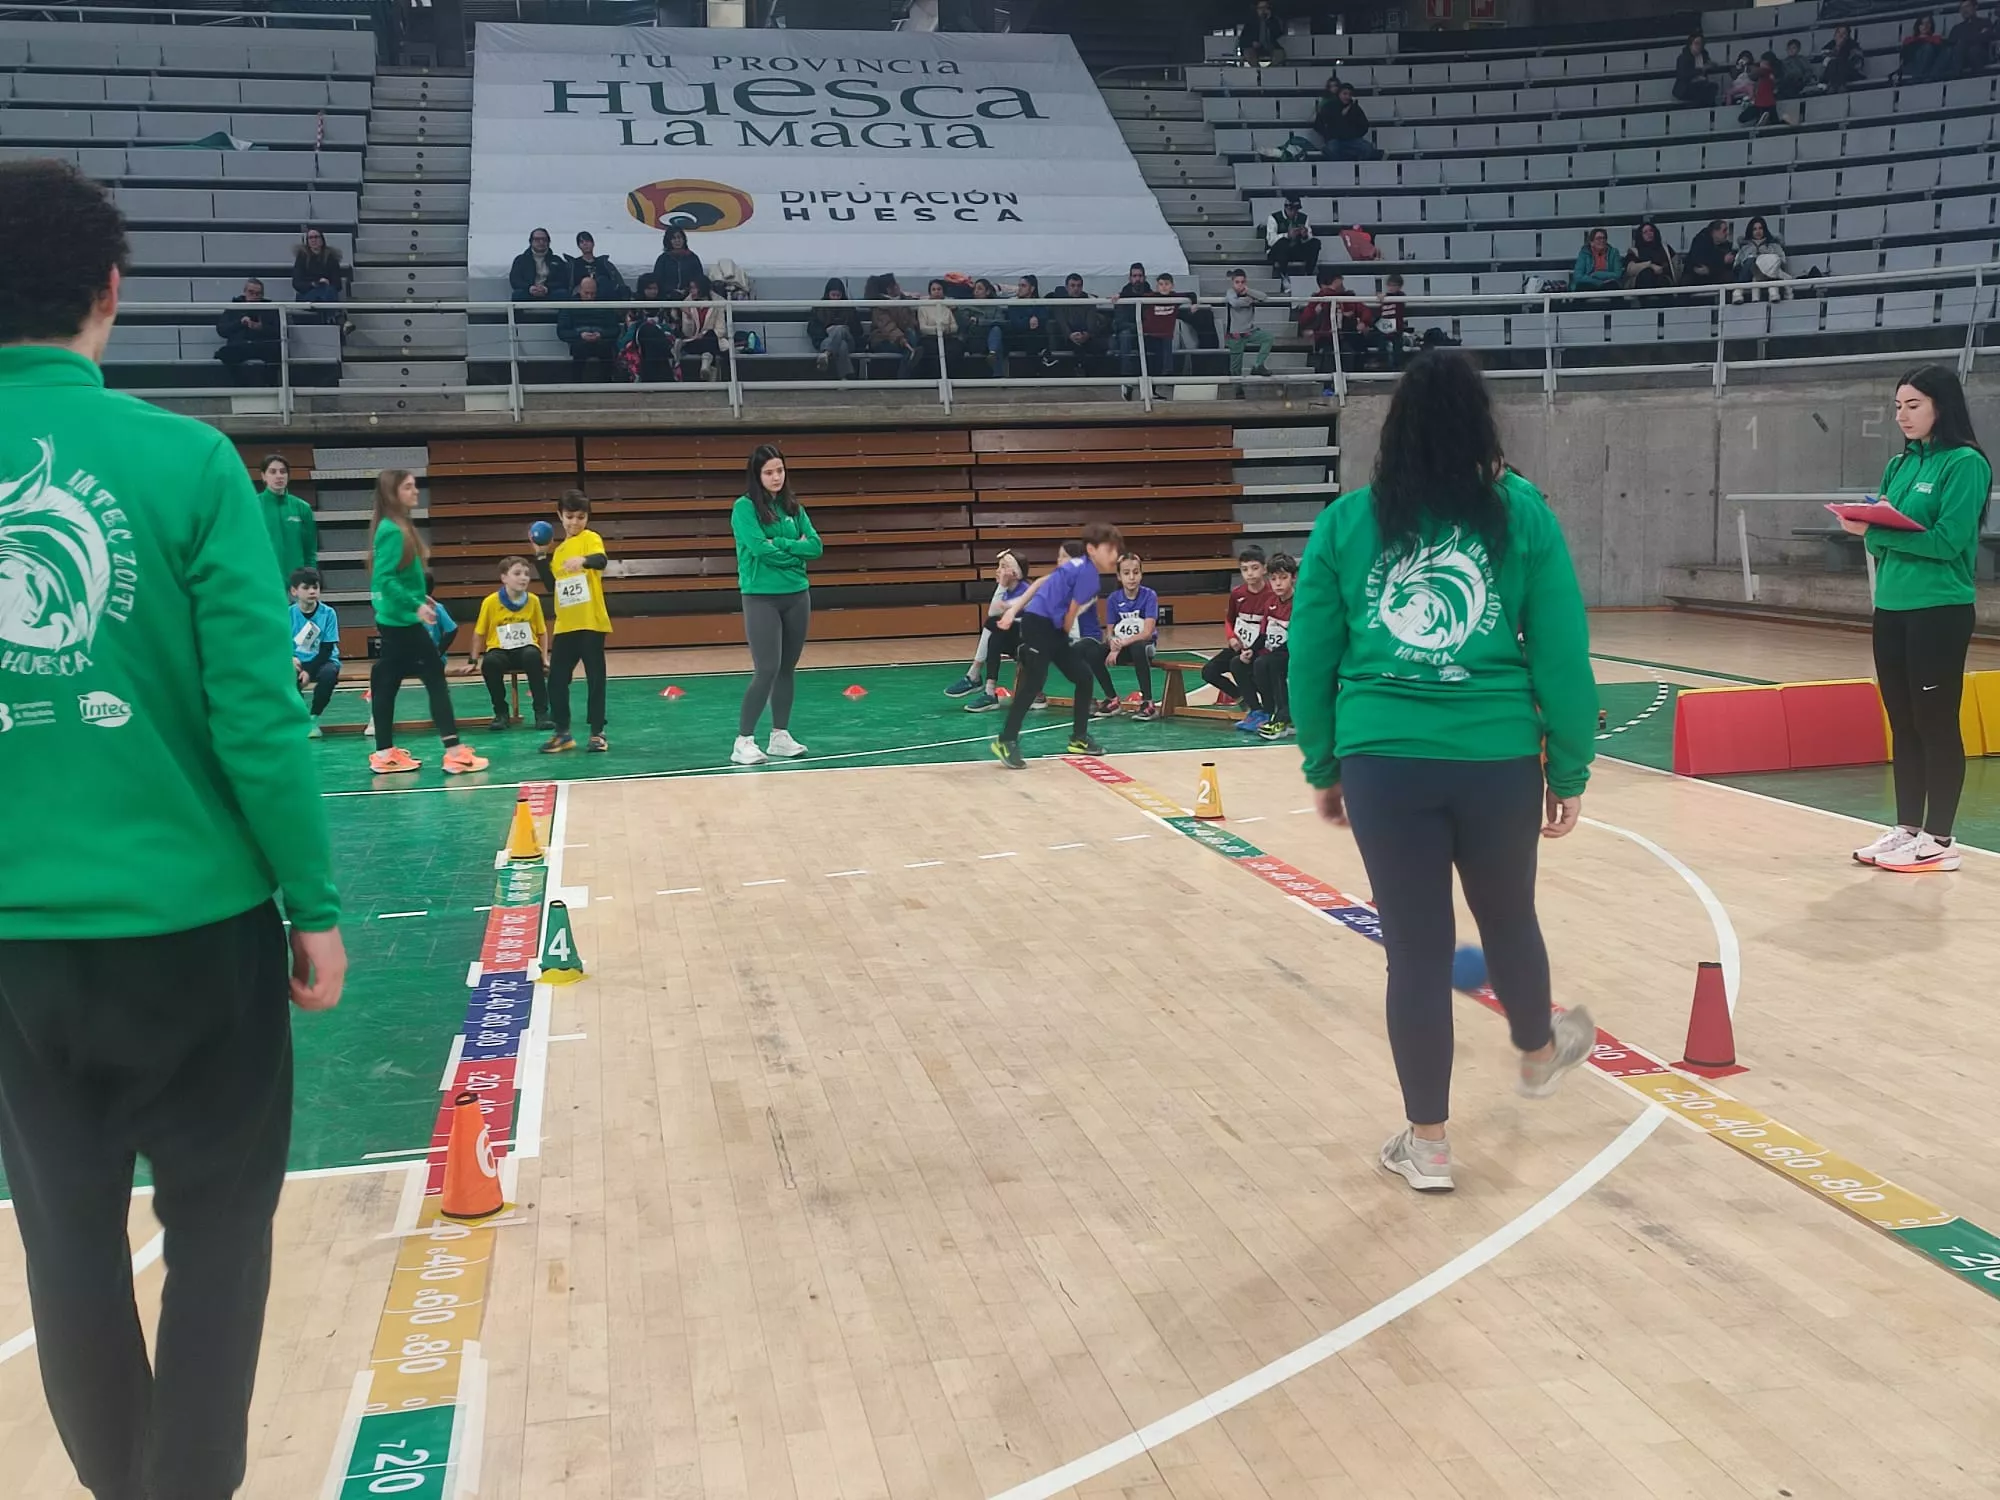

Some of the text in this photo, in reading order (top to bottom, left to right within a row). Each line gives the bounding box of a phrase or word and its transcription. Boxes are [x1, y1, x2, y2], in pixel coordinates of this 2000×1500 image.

[783, 207, 1024, 222] HUESCA
[562, 583, 583, 597] 425
[1119, 625, 1140, 636] 463
[1267, 634, 1283, 645] 52
[0, 650, 94, 676] HUESCA
[1197, 779, 1211, 804] 2
[548, 928, 571, 962] 4
